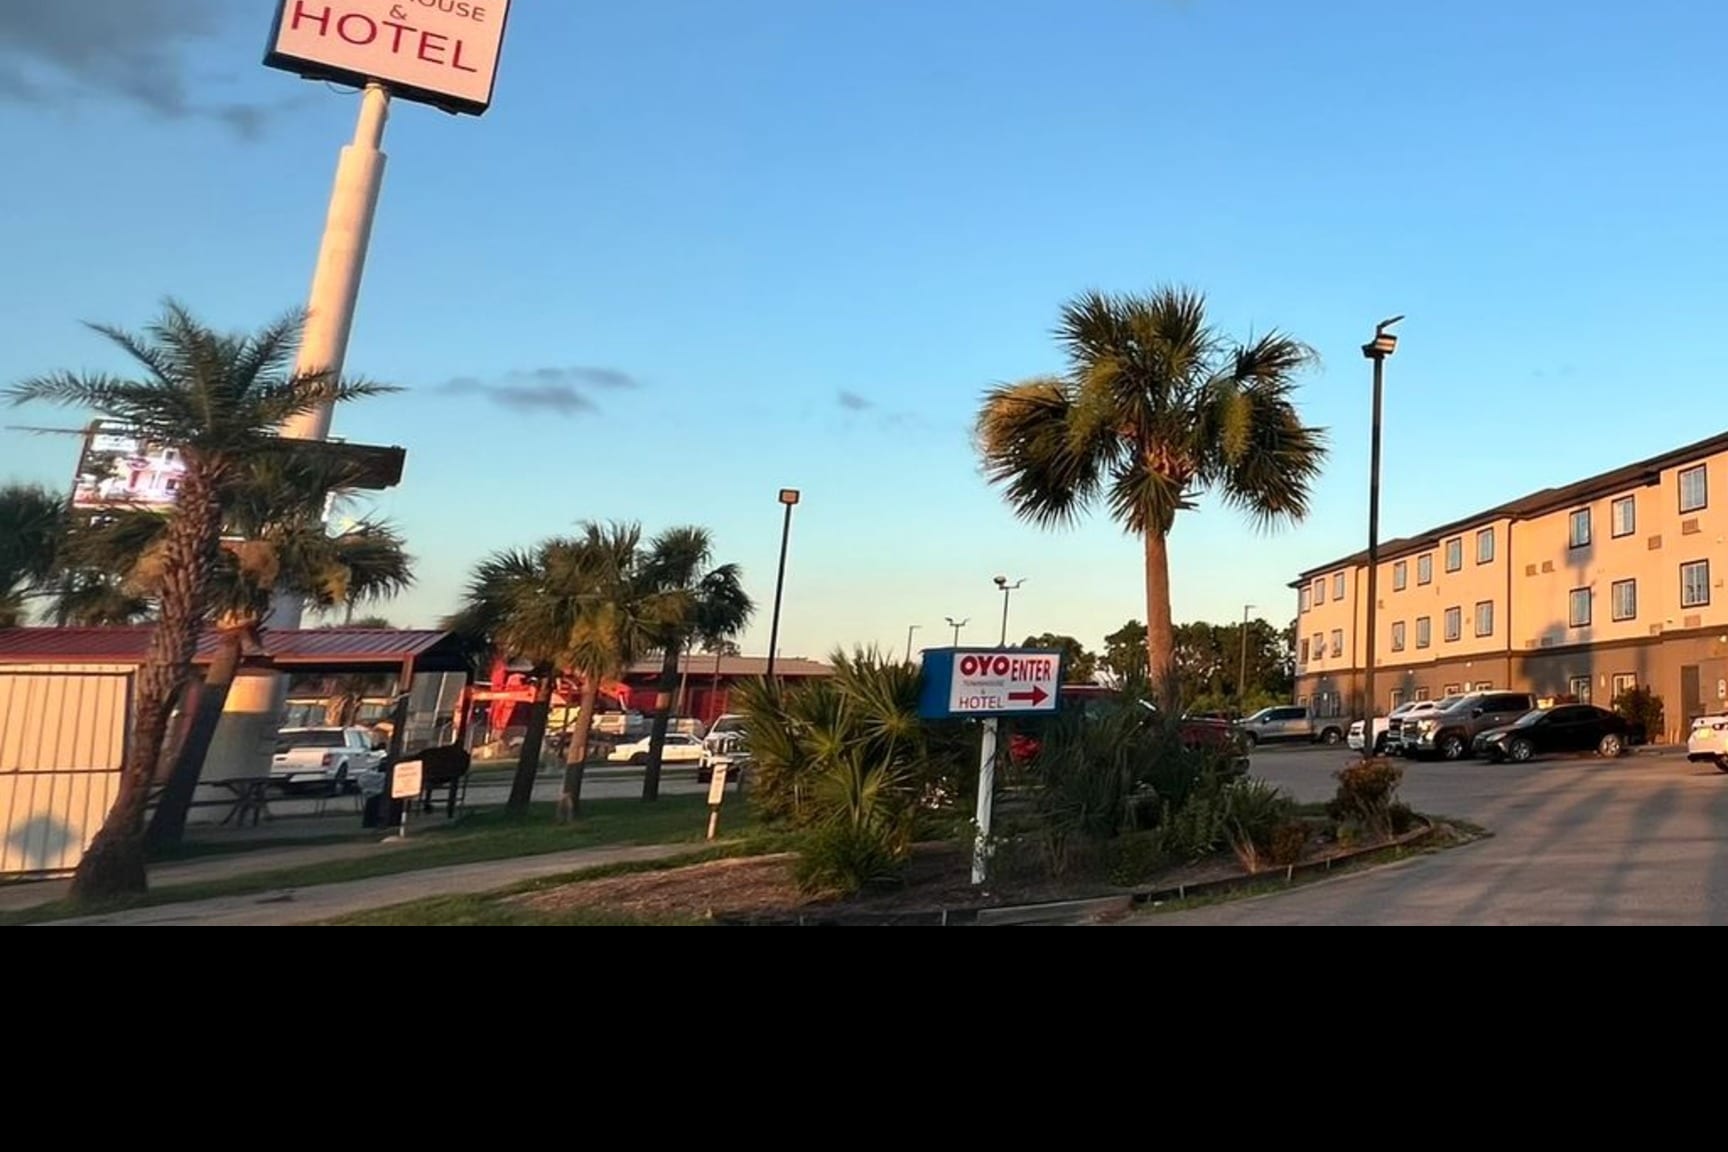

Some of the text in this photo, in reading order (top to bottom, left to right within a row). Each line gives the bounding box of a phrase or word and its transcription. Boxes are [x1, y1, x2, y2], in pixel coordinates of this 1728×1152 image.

[389, 4, 407, 20] &
[291, 0, 477, 73] HOTEL
[960, 655, 1010, 676] OYO
[1011, 659, 1051, 682] ENTER
[959, 695, 1004, 709] HOTEL
